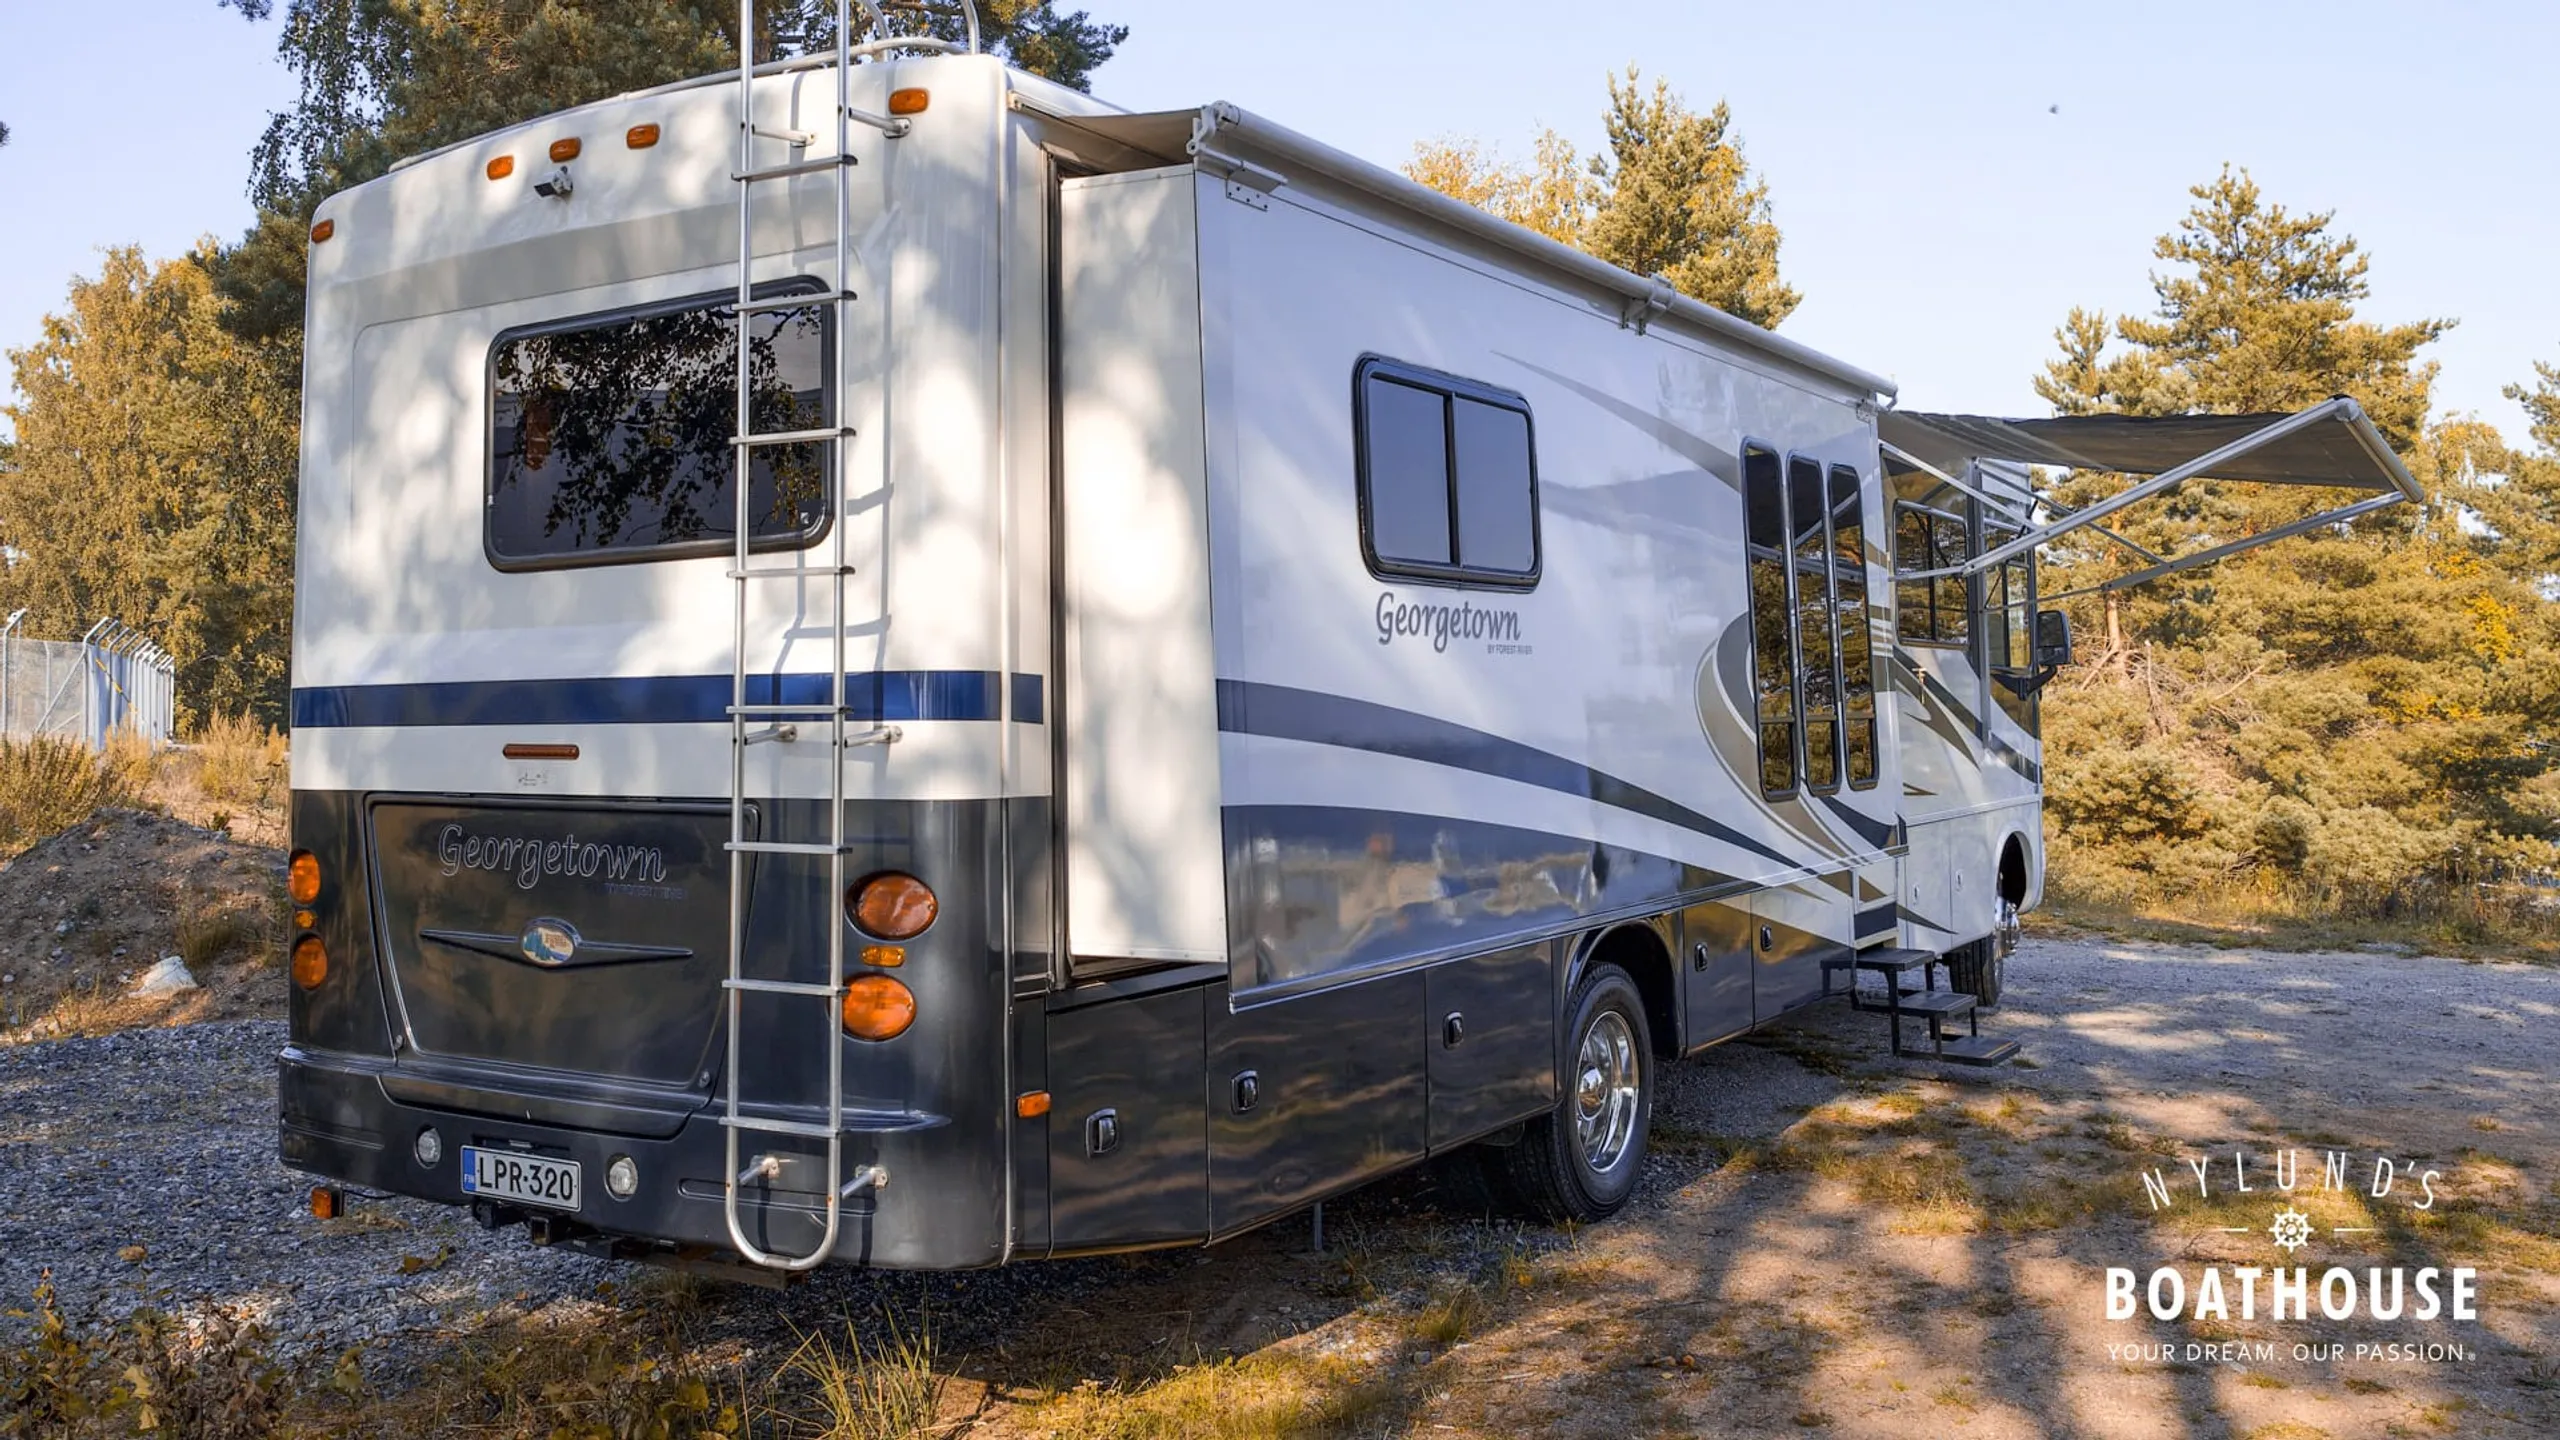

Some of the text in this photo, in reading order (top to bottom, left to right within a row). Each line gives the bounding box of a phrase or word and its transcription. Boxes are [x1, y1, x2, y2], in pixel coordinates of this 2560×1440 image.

[1376, 591, 1521, 654] Georgetown
[438, 823, 667, 889] Georgetown
[479, 1156, 574, 1201] LPR-320
